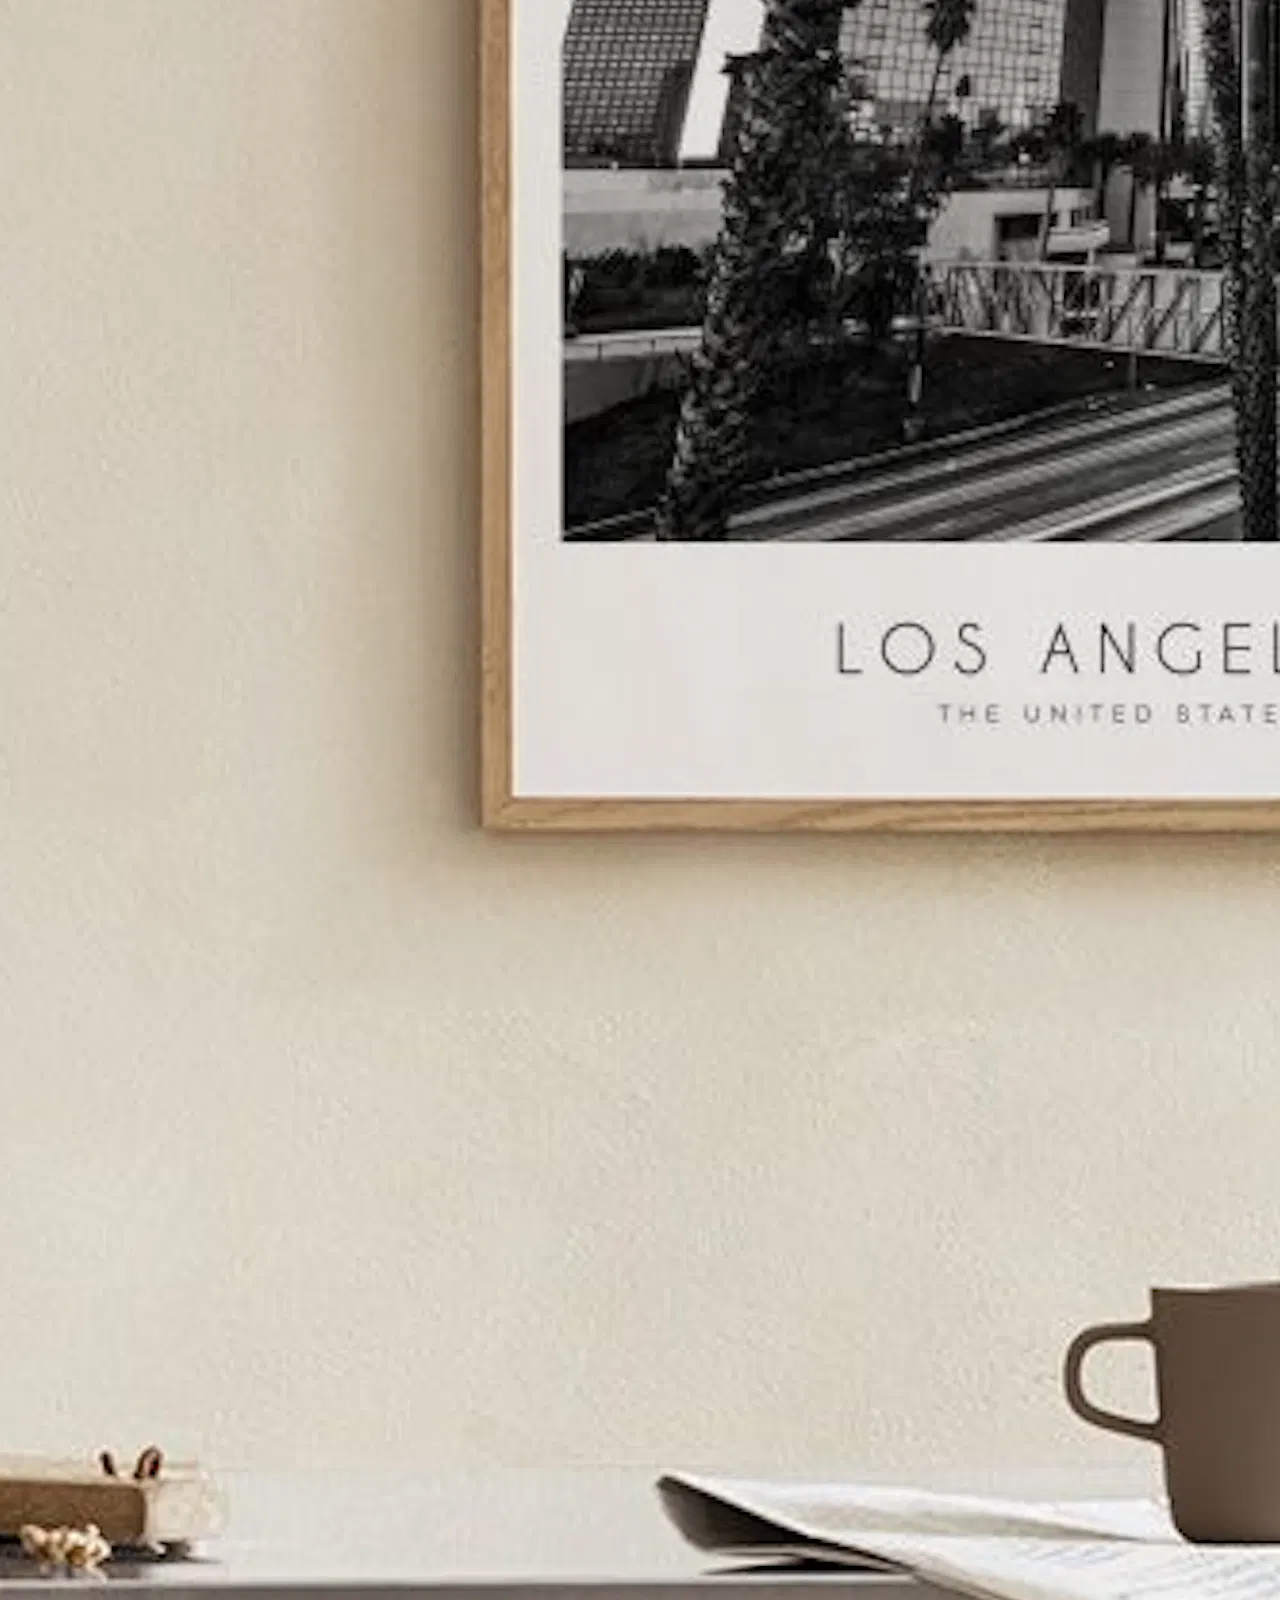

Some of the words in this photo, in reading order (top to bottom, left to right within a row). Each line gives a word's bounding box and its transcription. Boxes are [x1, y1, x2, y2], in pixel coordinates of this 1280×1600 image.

[837, 621, 987, 676] LOS
[938, 702, 1001, 725] THE
[1022, 702, 1152, 725] UNITED
